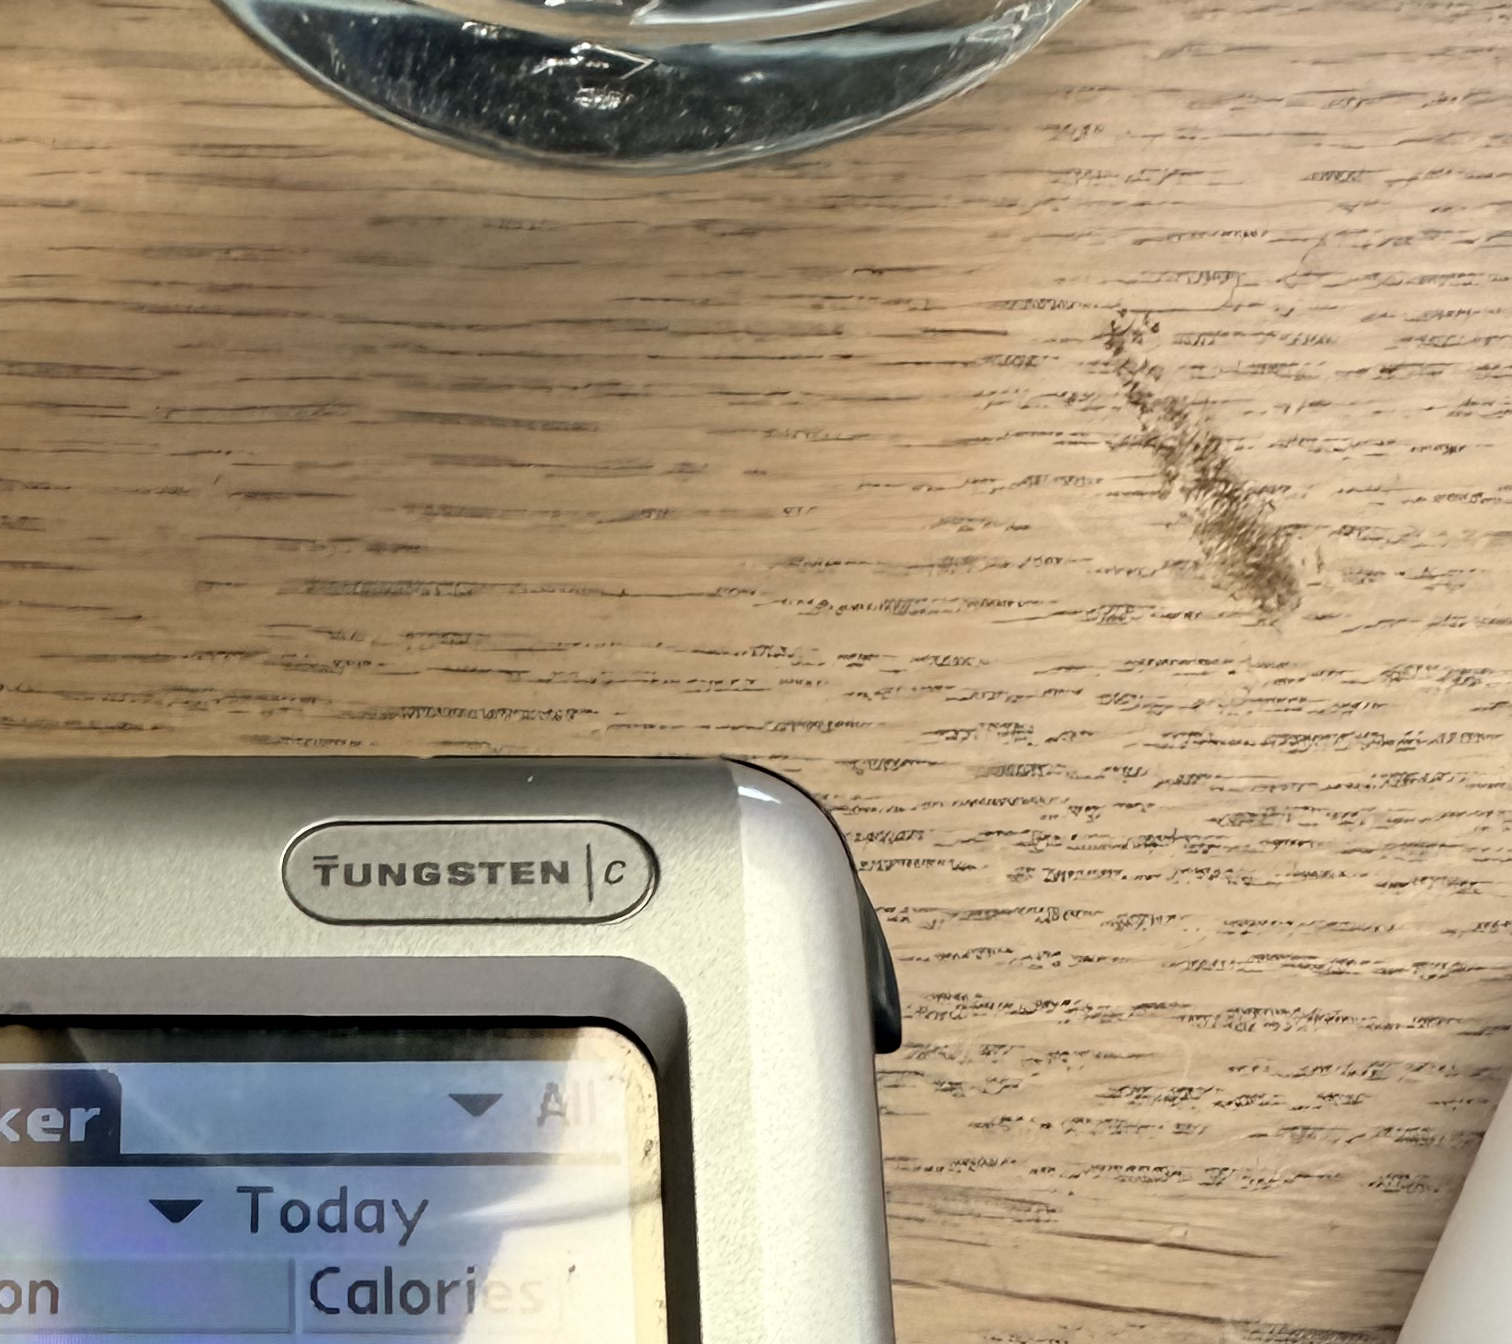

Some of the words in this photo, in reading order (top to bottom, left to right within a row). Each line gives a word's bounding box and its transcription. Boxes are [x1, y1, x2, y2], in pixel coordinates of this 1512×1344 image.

[313, 855, 570, 887] TUNGSTEN
[536, 1081, 596, 1127] All
[236, 1186, 429, 1247] Today
[309, 1265, 544, 1316] Calories
